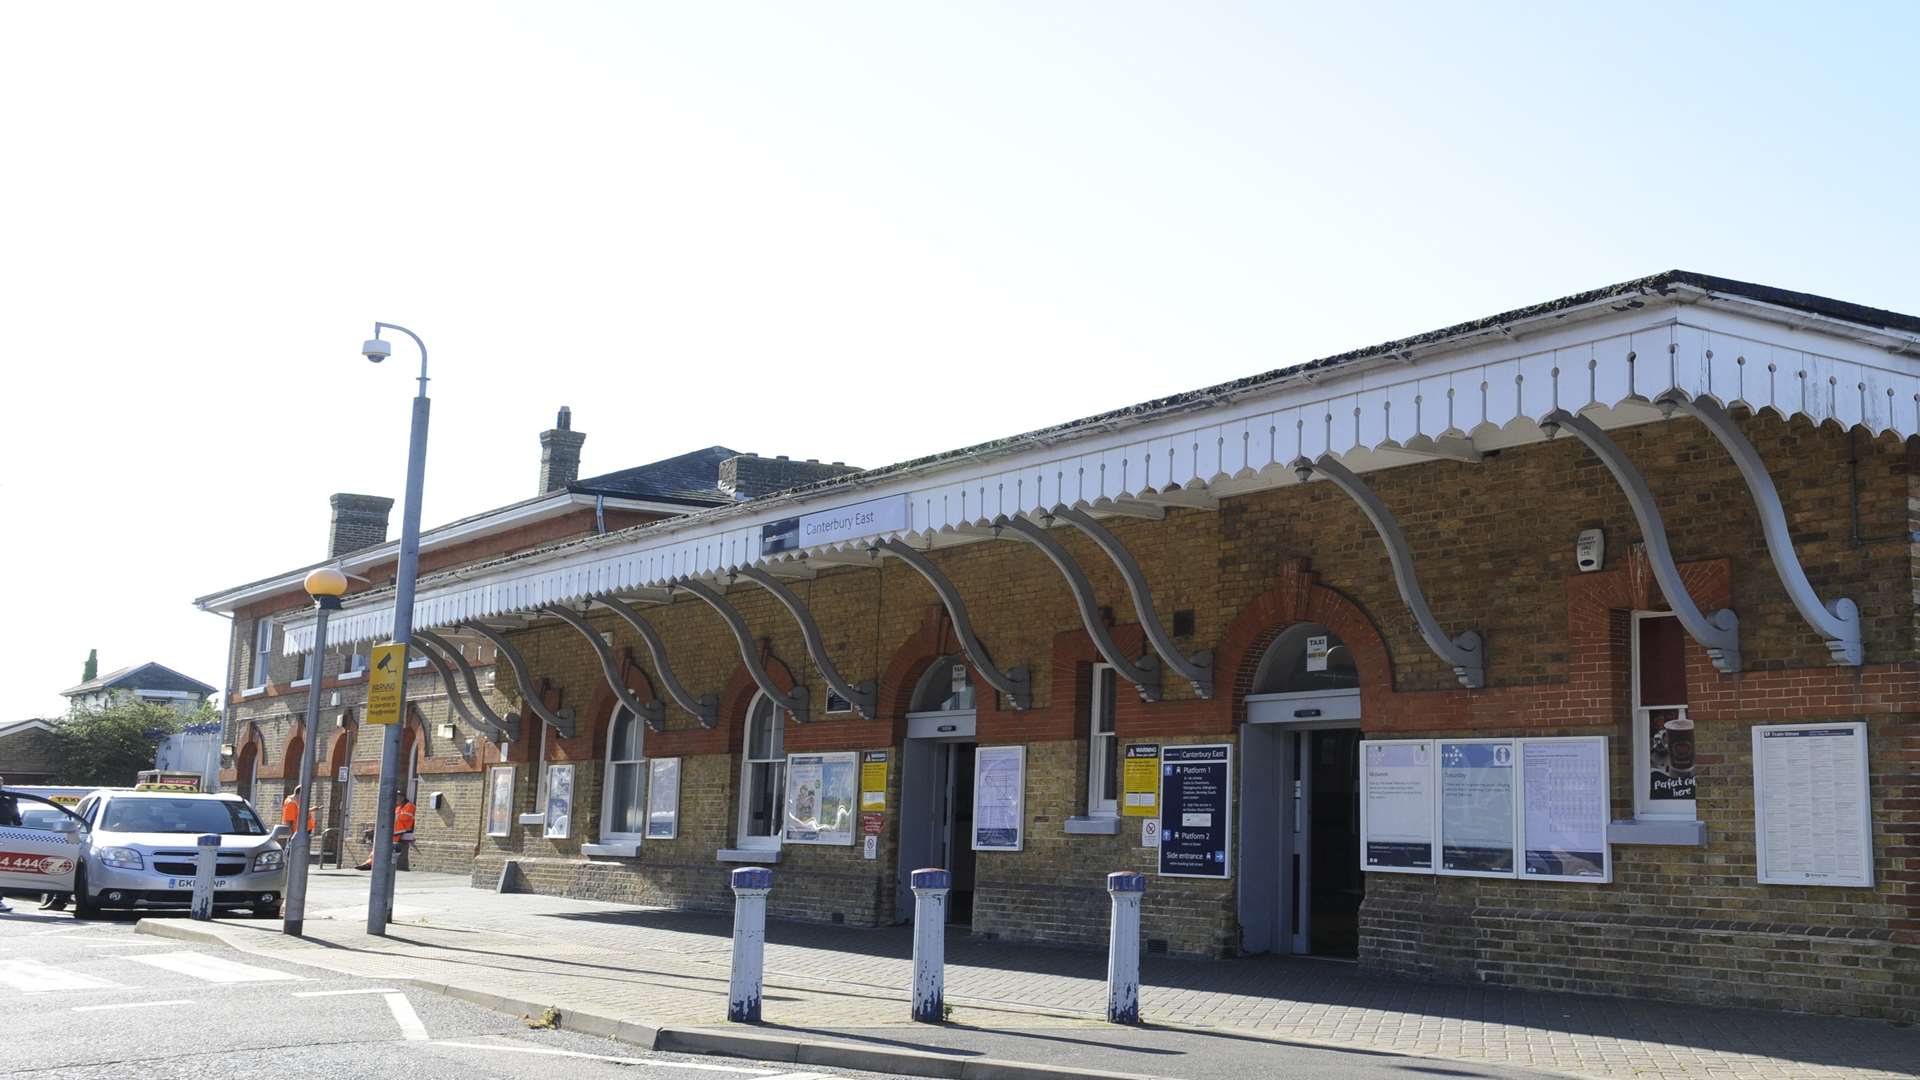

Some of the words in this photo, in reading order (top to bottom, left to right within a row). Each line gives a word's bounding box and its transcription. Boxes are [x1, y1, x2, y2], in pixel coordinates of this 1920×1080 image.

[806, 517, 853, 536] Canterbury
[855, 511, 874, 526] East
[1182, 751, 1211, 759] Canterbury
[1212, 750, 1225, 758] East
[1183, 766, 1207, 774] Platform
[143, 784, 194, 792] TAXI
[1654, 776, 1683, 791] Perfect
[1672, 787, 1692, 797] here
[1181, 832, 1206, 840] Platform
[1166, 851, 1178, 859] Side
[1179, 852, 1204, 860] entrance
[13, 857, 39, 867] 444
